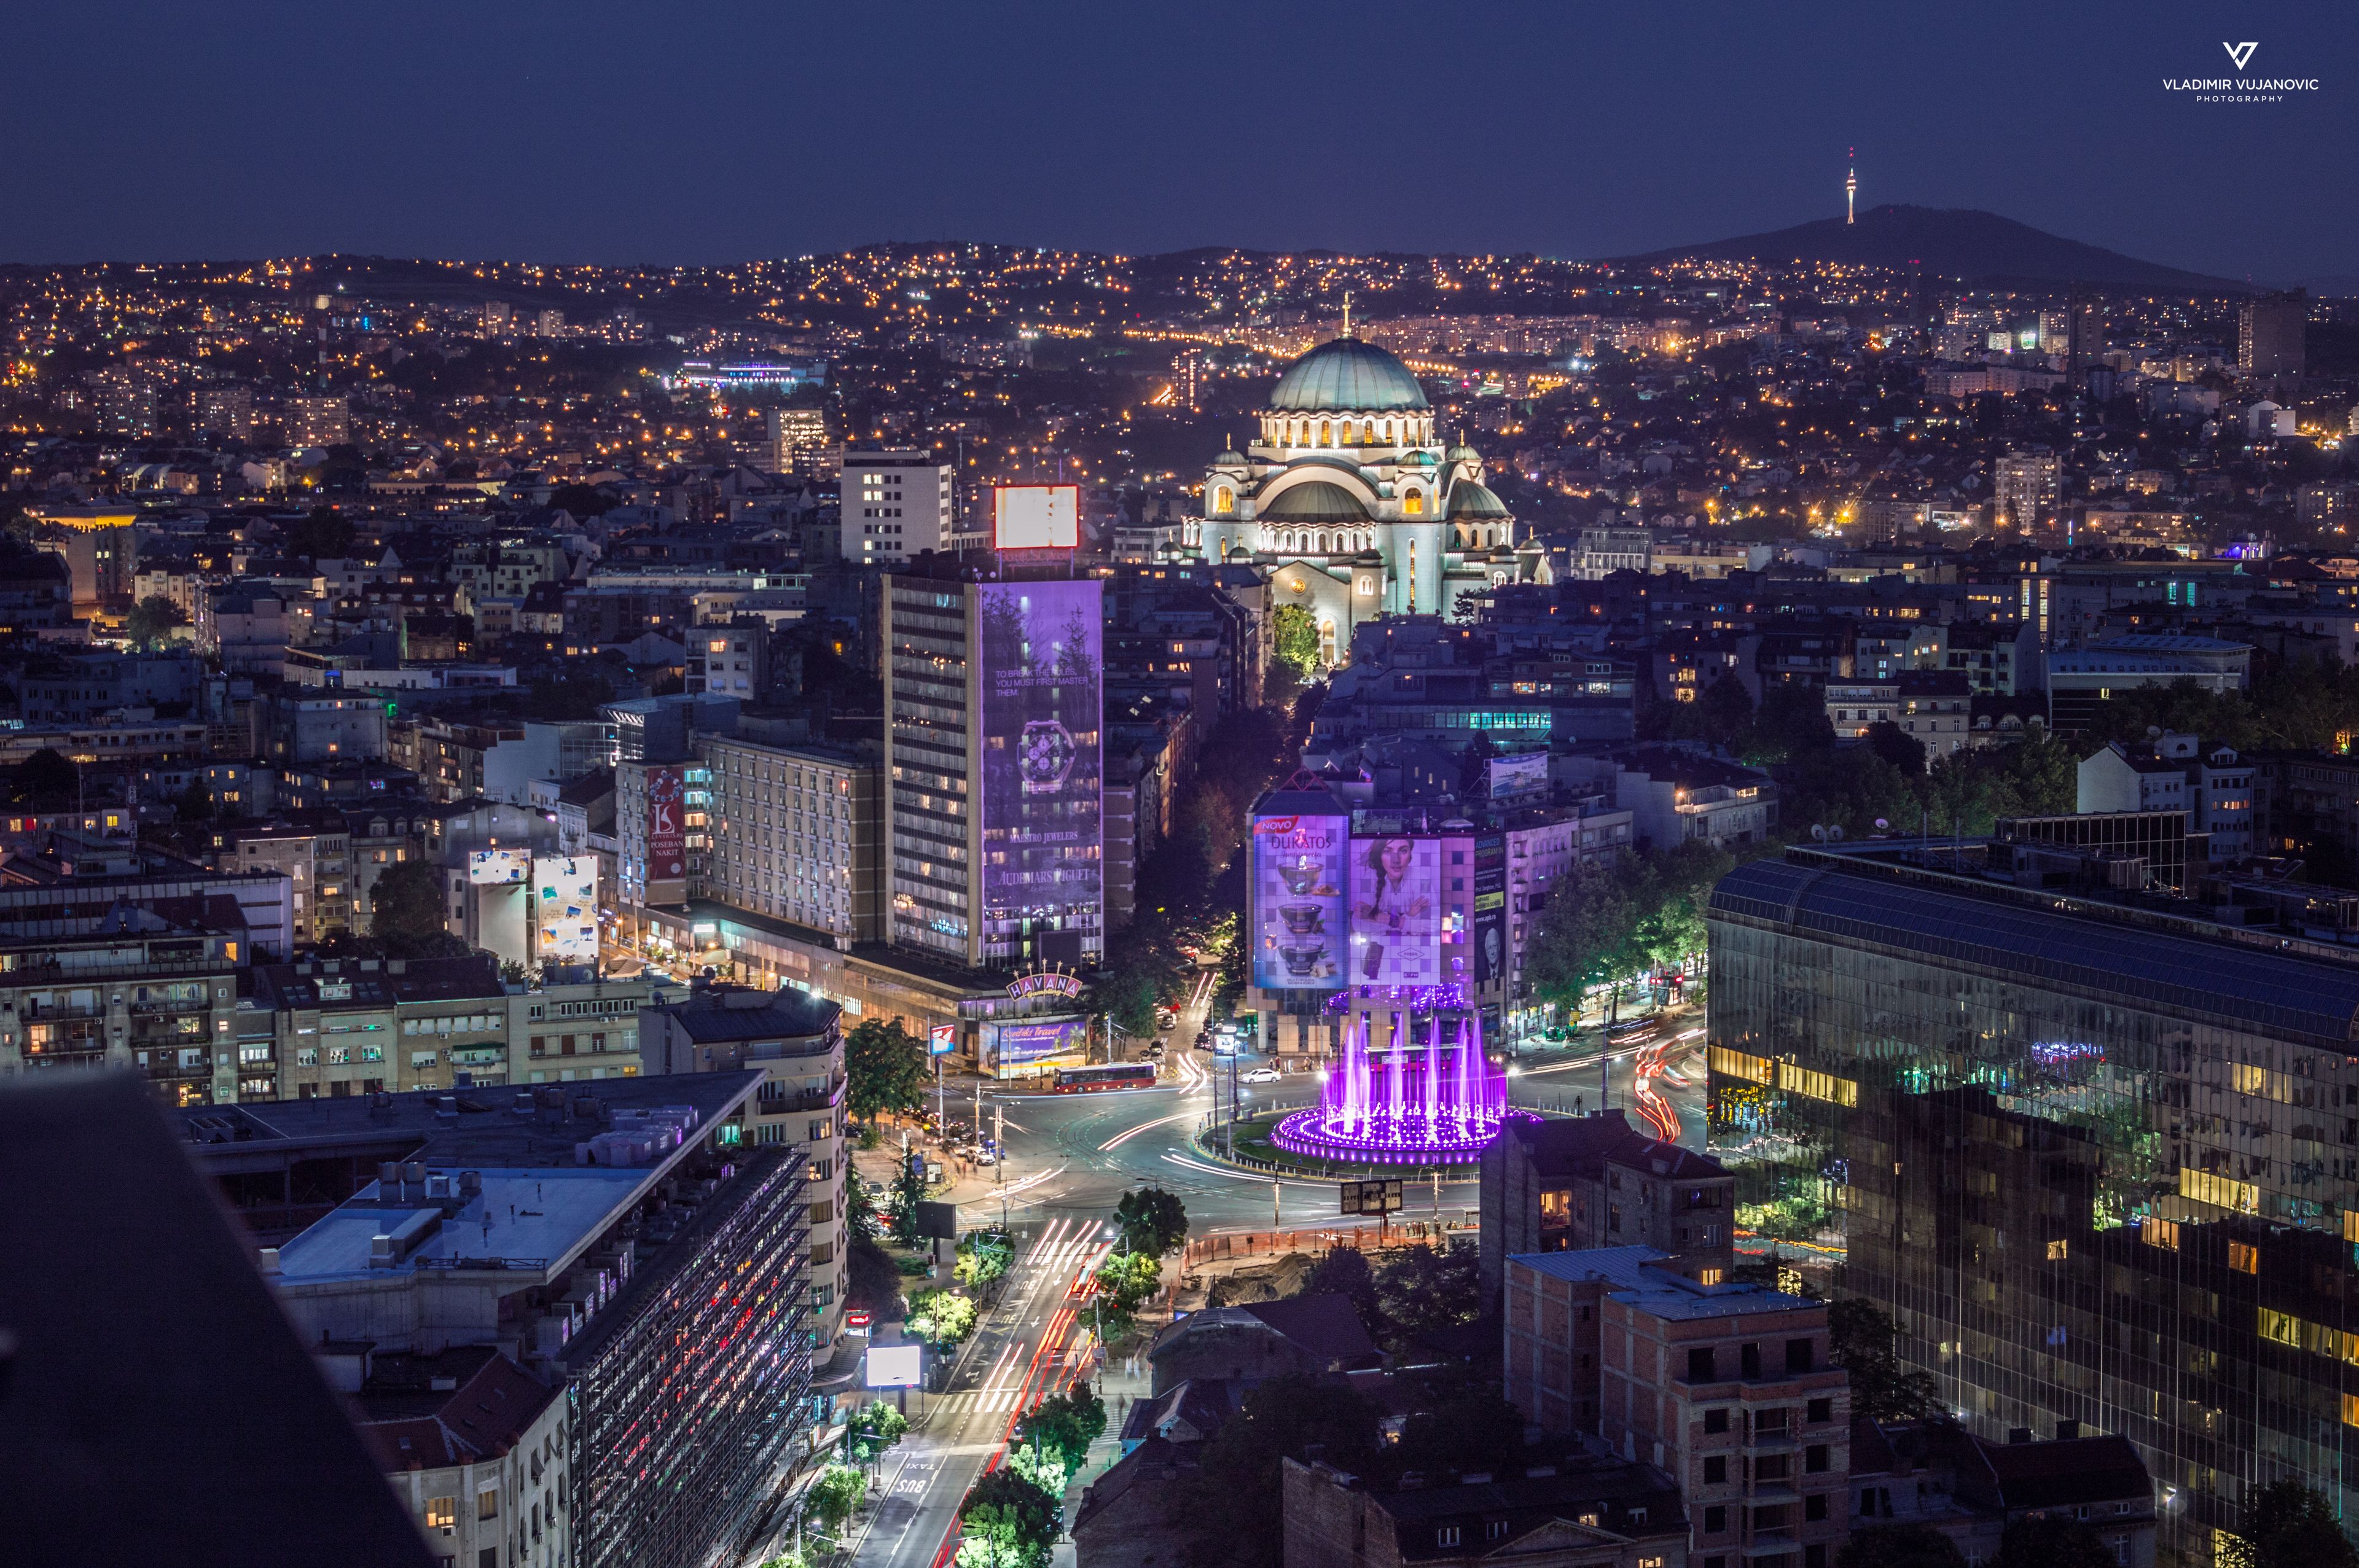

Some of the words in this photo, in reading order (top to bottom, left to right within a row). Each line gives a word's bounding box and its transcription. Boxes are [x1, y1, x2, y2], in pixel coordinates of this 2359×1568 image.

[1036, 677, 1057, 686] FIRST
[1262, 821, 1292, 830] NOVO
[1009, 833, 1042, 843] MAESTRO
[1043, 831, 1078, 844] JEWELERS
[1271, 836, 1332, 849] DUKATOS
[1476, 838, 1500, 849] ADVANCED
[998, 870, 1052, 886] AUDEMARS
[1054, 868, 1090, 882] PIGUET
[1011, 977, 1077, 997] HAVANA
[1027, 988, 1062, 998] Gambling
[1034, 1024, 1063, 1036] Travel
[1013, 1280, 1037, 1290] BUS
[896, 1479, 926, 1493] BUS
